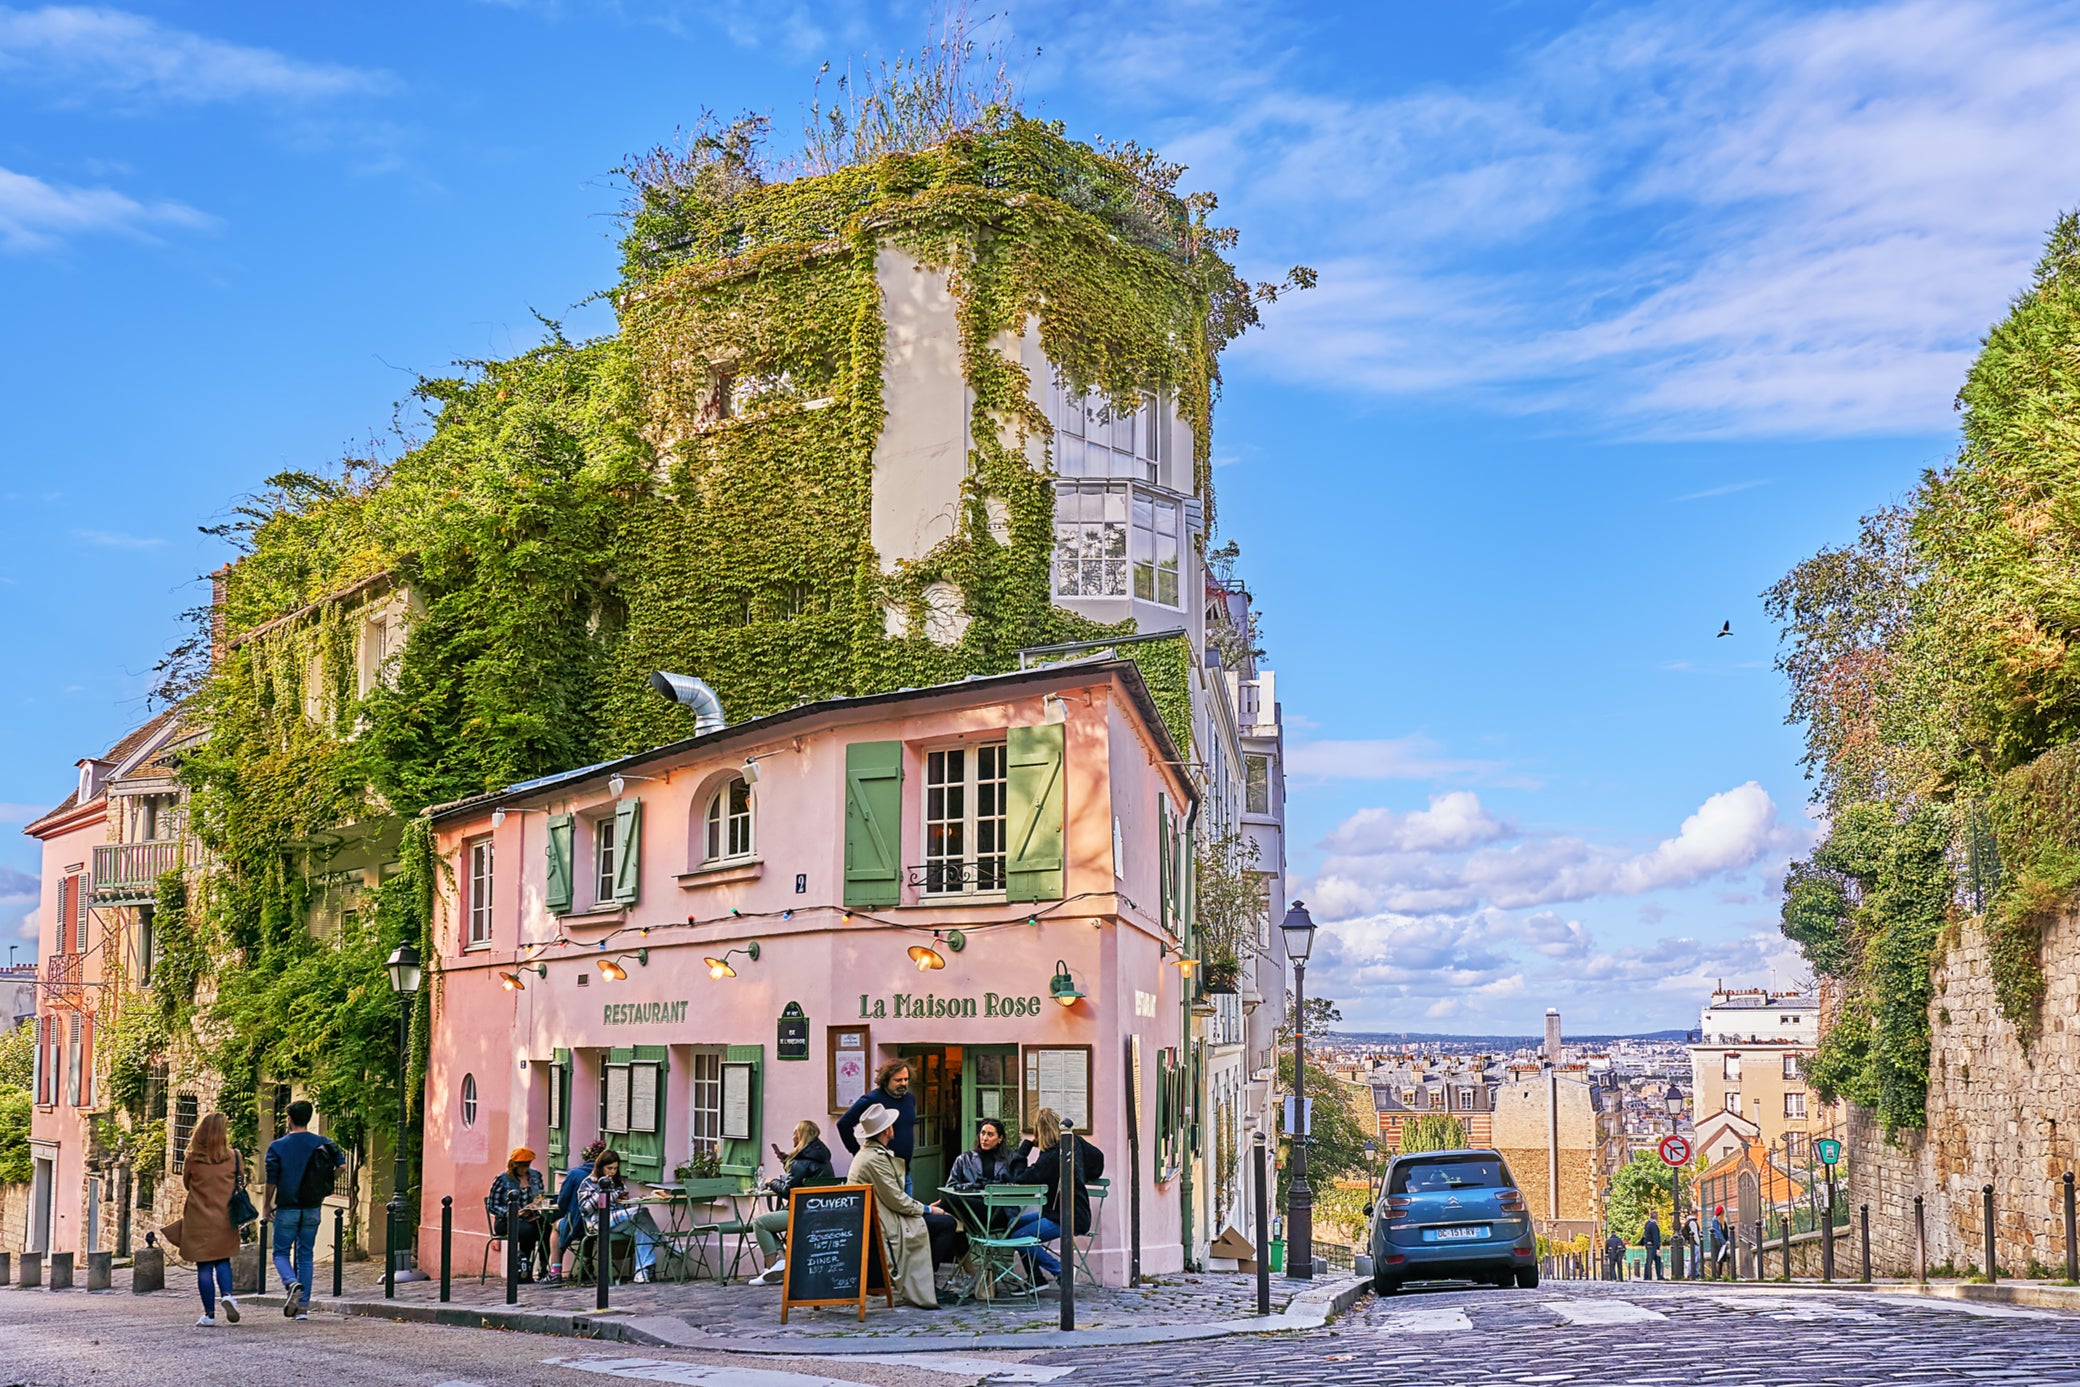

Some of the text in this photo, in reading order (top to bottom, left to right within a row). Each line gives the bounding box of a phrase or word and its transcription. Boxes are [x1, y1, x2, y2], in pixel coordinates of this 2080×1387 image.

[797, 875, 805, 893] 2
[603, 1001, 688, 1025] RESTAURANT
[859, 992, 1041, 1018] La Maison Rose
[806, 1196, 860, 1210] OUVERT
[807, 1230, 853, 1243] BOISSONS
